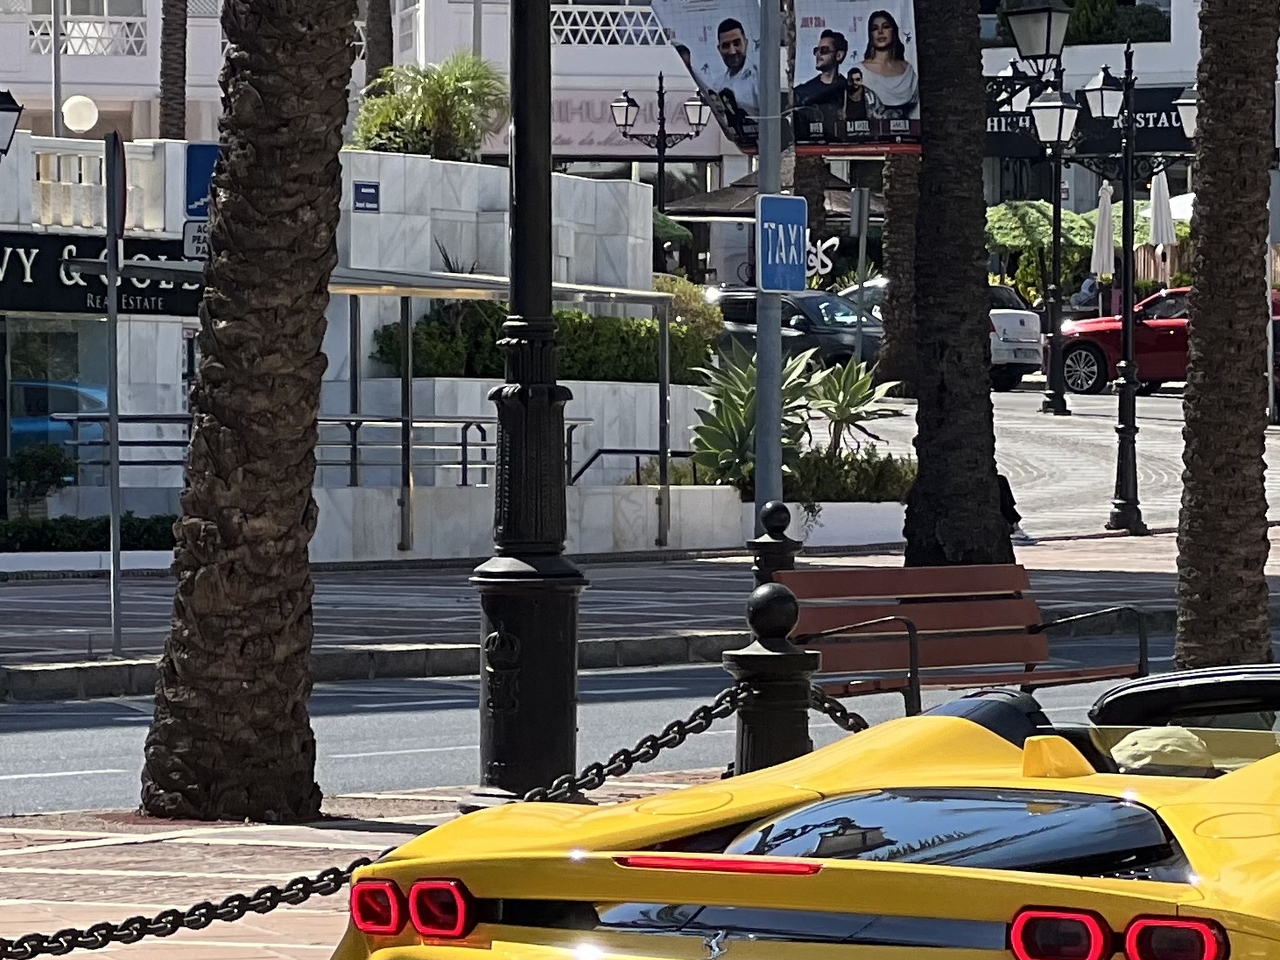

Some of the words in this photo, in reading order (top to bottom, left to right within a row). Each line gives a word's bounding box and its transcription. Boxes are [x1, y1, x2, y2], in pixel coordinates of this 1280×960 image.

[1112, 112, 1181, 129] RSTAU
[763, 222, 804, 265] TAXI
[121, 293, 164, 311] ESTATE
